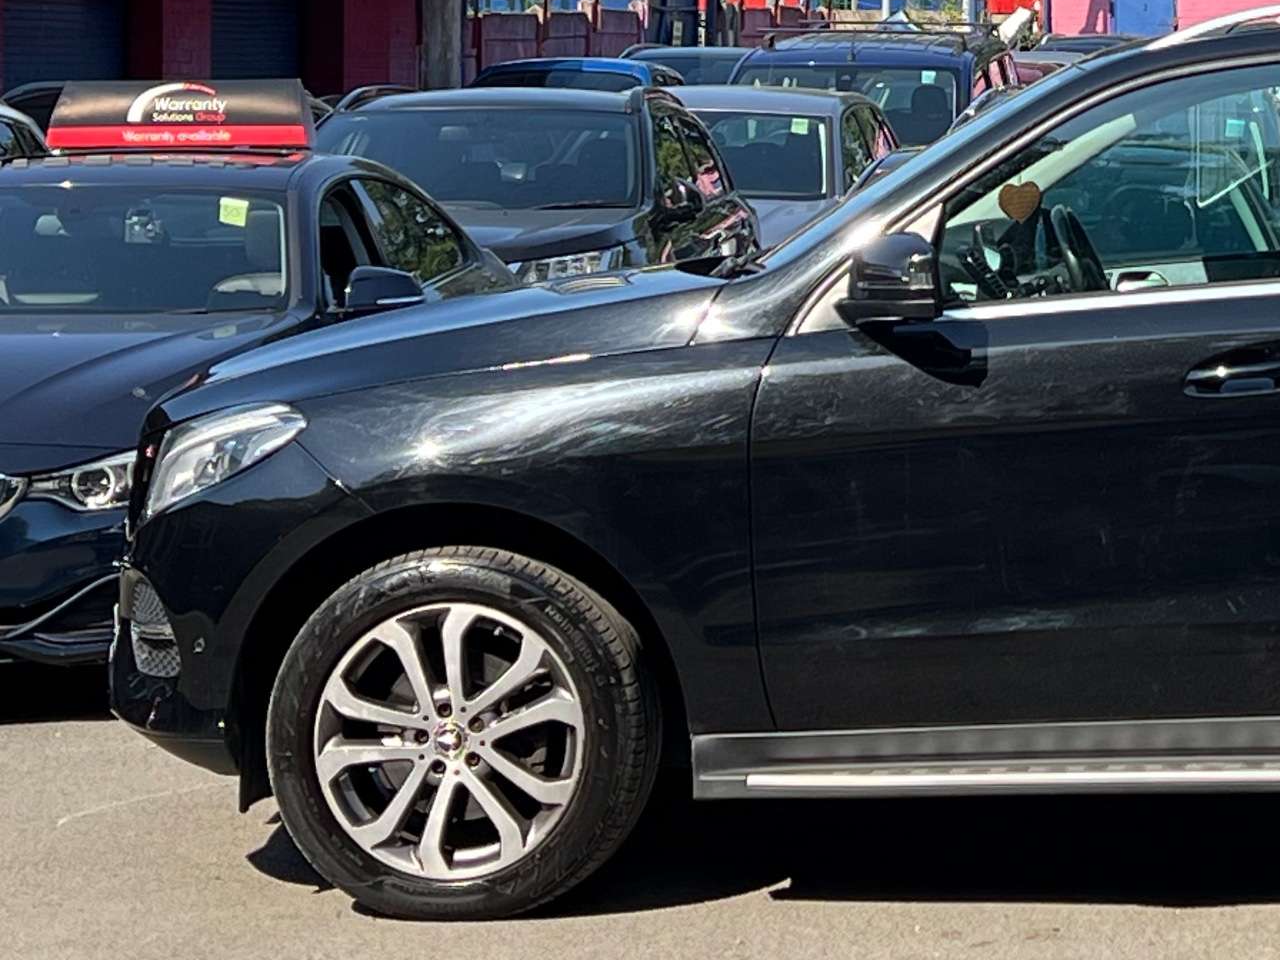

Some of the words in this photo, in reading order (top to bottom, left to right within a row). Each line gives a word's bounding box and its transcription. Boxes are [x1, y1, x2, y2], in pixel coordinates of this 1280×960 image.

[154, 97, 226, 114] Warranty
[152, 112, 193, 122] Solutions
[122, 131, 174, 143] Warranty
